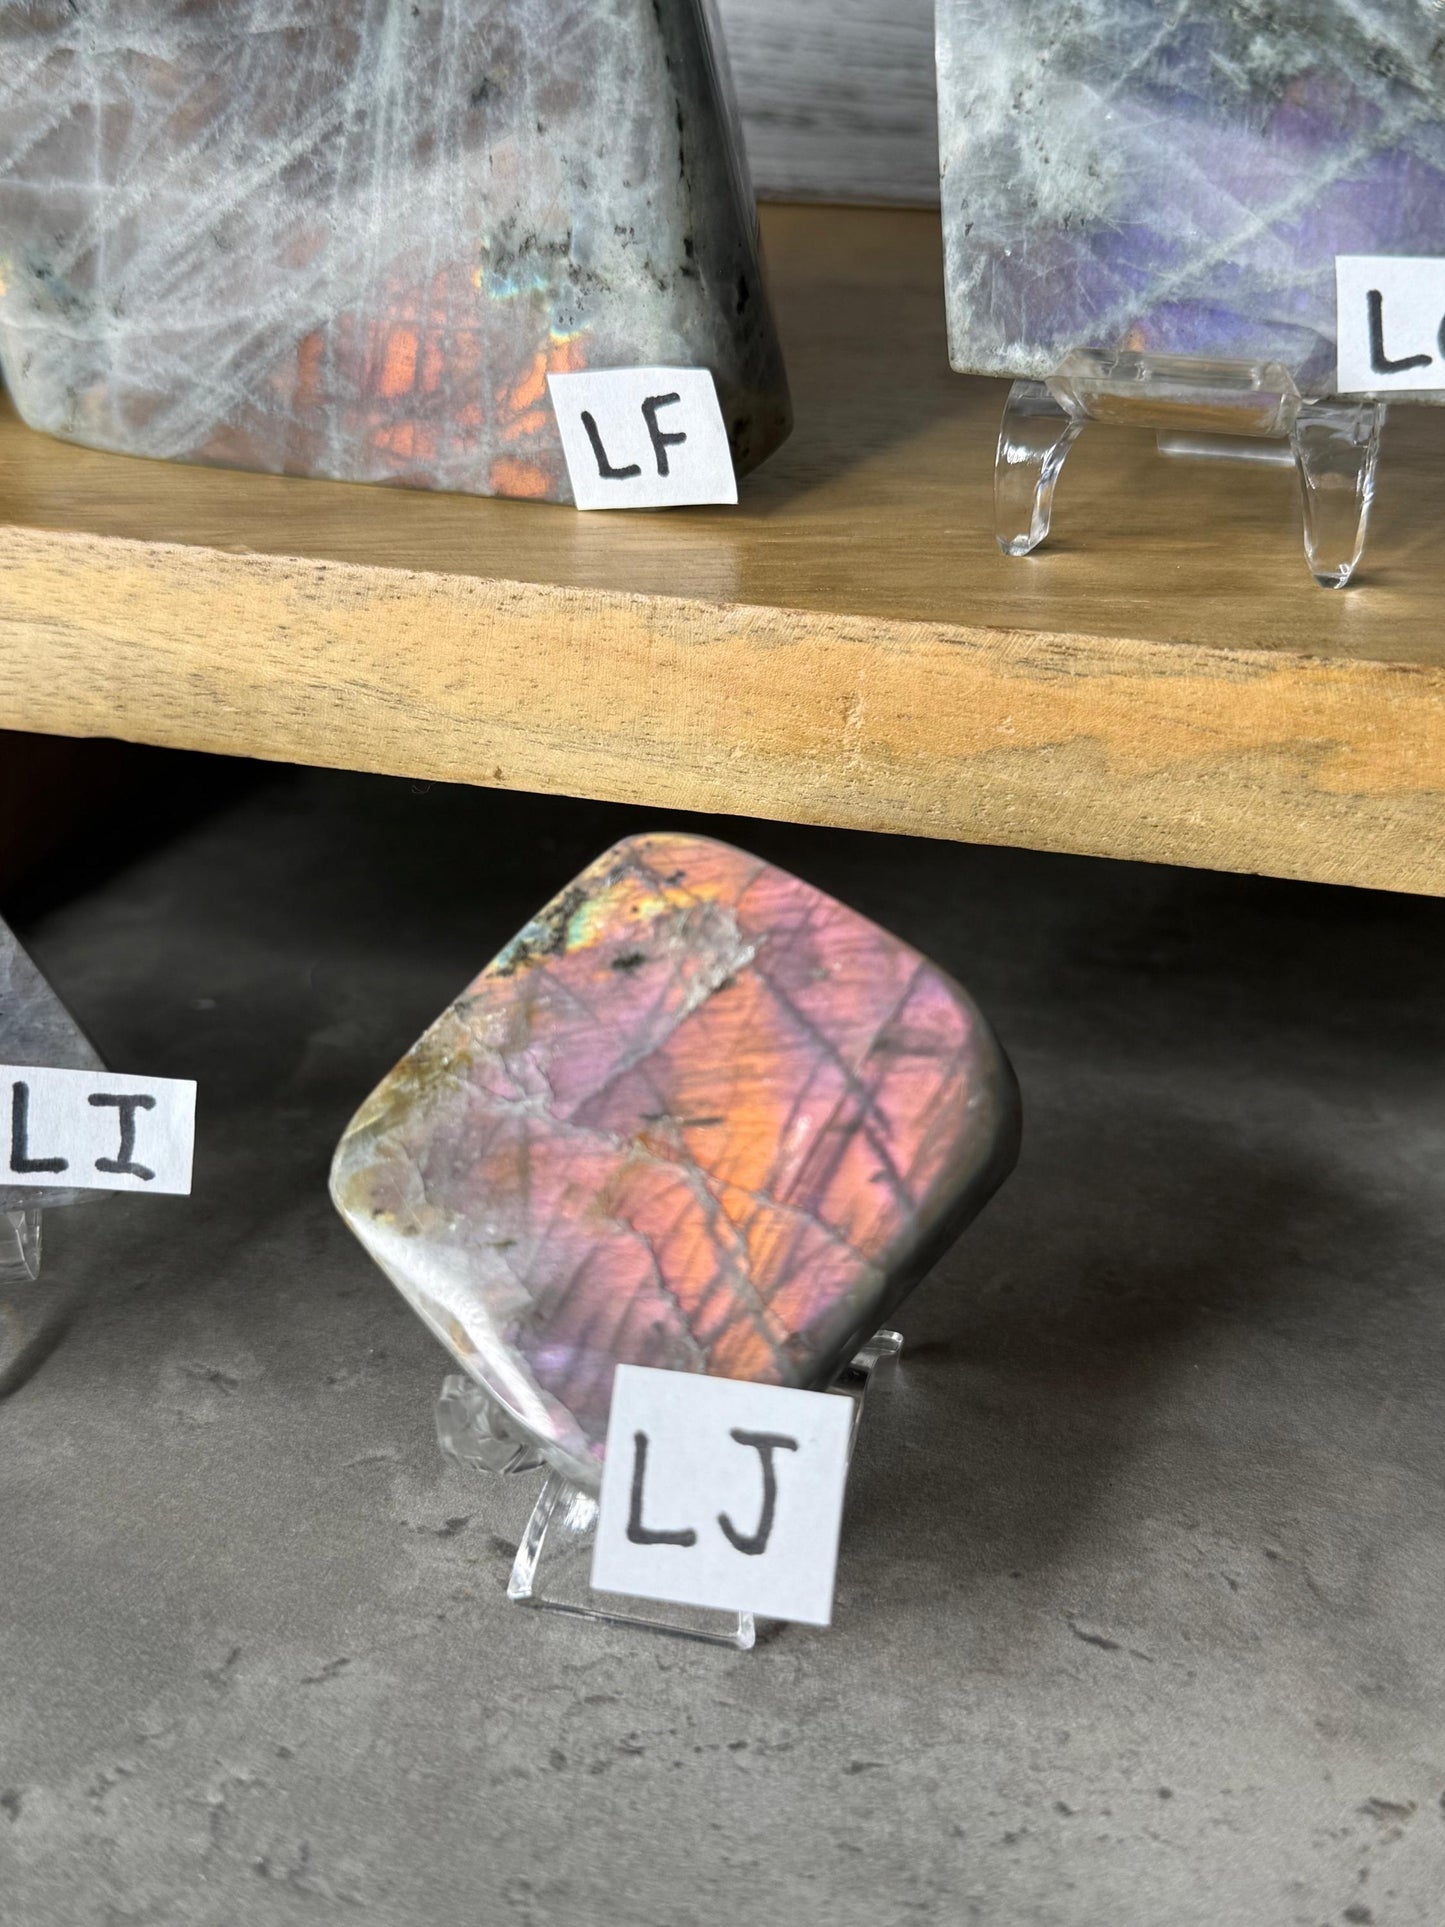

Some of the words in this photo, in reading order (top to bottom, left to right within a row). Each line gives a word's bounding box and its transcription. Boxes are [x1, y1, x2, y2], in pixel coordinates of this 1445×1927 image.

[1366, 289, 1445, 374] L
[580, 391, 688, 481] LF
[9, 1080, 157, 1182] LI
[626, 1428, 798, 1556] LJ
